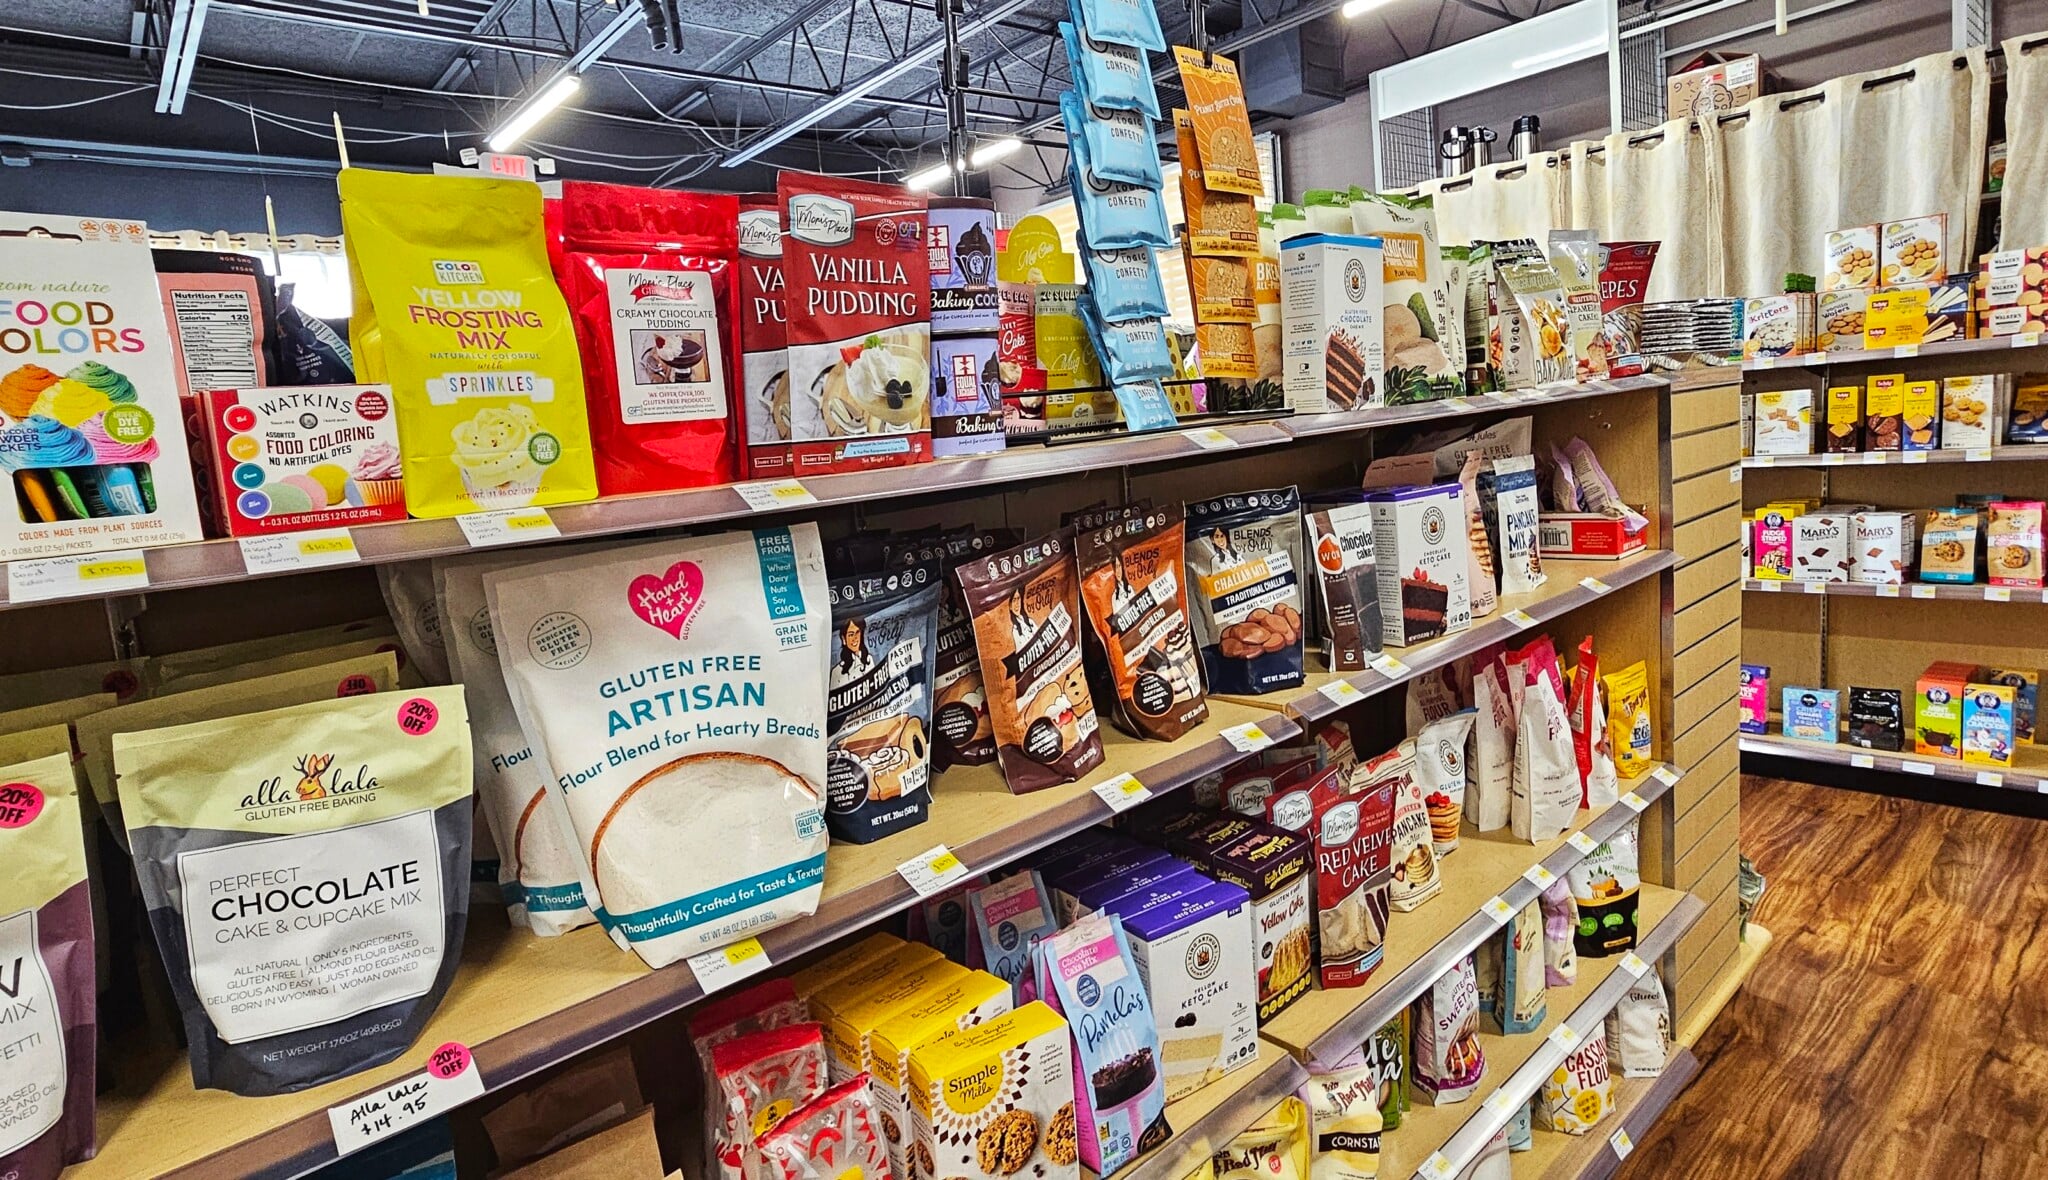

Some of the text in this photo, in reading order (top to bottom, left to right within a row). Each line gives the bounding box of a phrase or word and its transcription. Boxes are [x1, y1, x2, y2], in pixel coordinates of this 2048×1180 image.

[1111, 49, 1138, 61] LOGIC
[1106, 60, 1139, 79] CONFETTI
[1116, 116, 1142, 129] LOGIC
[1111, 128, 1144, 145] CONFETTI
[1108, 194, 1147, 209] CONFETTI
[799, 210, 849, 234] Mom's Place
[1122, 253, 1147, 263] LOGIC
[439, 271, 484, 282] KITCHEN
[809, 253, 909, 285] VANILLA
[1116, 267, 1149, 279] CONFETTI
[42, 281, 112, 293] nature
[667, 275, 695, 289] Place
[412, 286, 522, 308] YELLOW
[808, 287, 917, 316] PUDDING
[409, 305, 542, 329] FROSTING
[617, 309, 713, 319] CREAMY CHOCOLATE
[647, 319, 690, 328] PUDDING
[1340, 315, 1372, 323] CHOCOLATE
[457, 331, 511, 350] MIX
[1002, 331, 1026, 355] Cake
[1126, 329, 1157, 344] CONFETTI
[477, 361, 504, 370] with
[450, 375, 534, 393] SPRINKLES
[956, 375, 976, 388] EQUAL
[258, 394, 352, 416] WATKINS
[117, 427, 144, 436] FREE
[118, 418, 139, 429] DYE
[956, 416, 996, 435] Baking
[267, 426, 375, 454] FOOD COLORING
[1489, 445, 1511, 454] FREE
[269, 445, 351, 466] NO ARTIFICIAL DYES
[302, 513, 329, 523] BOTTLES
[1506, 509, 1537, 532] PANCAKE
[18, 520, 163, 541] COLORS MADE FROM PLANT SOURCES
[1234, 527, 1274, 540] BLENDS
[1801, 526, 1840, 538] MARY'S
[1856, 526, 1893, 538] MARY'S
[66, 541, 93, 549] PACKETS
[759, 535, 789, 547] FREE
[761, 544, 791, 555] FROM
[1508, 530, 1527, 551] MIX
[1125, 548, 1159, 567] BLENDS
[1356, 548, 1372, 561] cake
[1419, 554, 1451, 565] KETO CAKE
[1423, 548, 1447, 556] CHOCOLATE
[767, 563, 791, 573] Wheat
[1137, 561, 1157, 579] Orly
[769, 574, 789, 584] Dairy
[1214, 568, 1253, 592] CHALLAH
[637, 570, 689, 609] Hand
[770, 584, 788, 594] Nuts
[1226, 576, 1286, 606] TRADITIONAL CHALLAH
[648, 591, 693, 626] Heart
[772, 595, 786, 605] Soy
[775, 604, 800, 615] GMOs
[536, 623, 577, 646] DEDICATED
[775, 623, 808, 636] GRAIN
[540, 629, 581, 653] GLUTEN
[550, 640, 576, 657] FREE
[781, 633, 807, 646] FREE
[599, 656, 761, 698] GLUTEN FREE
[830, 662, 889, 713] GLUTEN-FREE
[410, 702, 433, 720] 20%
[608, 682, 766, 737] ARTISAN
[1423, 701, 1452, 721] FLOUR
[1921, 711, 1957, 720] COOKIES
[403, 716, 425, 732] OFF
[1967, 721, 2009, 730] CRACKERS
[1970, 716, 2006, 724] ANIMAL
[559, 720, 820, 795] Flour Blend for Hearty Breads
[241, 764, 379, 808] alla lala
[246, 792, 376, 822] GLUTEN FREE BAKING
[1392, 811, 1428, 844] PANCAKE
[1320, 849, 1350, 873] RED
[210, 866, 300, 895] PERFECT
[1342, 856, 1378, 888] CAKE
[211, 860, 420, 922] CHOCOLATE
[216, 889, 421, 944] CAKE CUPCAKE MIX
[621, 880, 786, 935] Thoughtfully Crafted for Taste
[1261, 895, 1305, 932] Yellow Cake
[256, 931, 413, 973] NATURAL ONLY INGREDIENTS
[1062, 946, 1098, 968] Chocolate
[226, 938, 419, 990] GLUTEN FREE ALMOND FLOUR BASED
[1064, 965, 1082, 977] Cake
[207, 978, 313, 1006] DELICIOUS EASY
[231, 961, 418, 1013] BORN WYOMING WOMAN OWNED
[1181, 981, 1229, 1010] KETO CAKE
[1194, 981, 1216, 993] YELLOW
[1080, 986, 1144, 1053] Pamela's
[286, 1041, 327, 1057] WEIGHT
[432, 1046, 462, 1067] 20%
[440, 1061, 463, 1076] OFF
[949, 1064, 998, 1093] Simple
[350, 1080, 428, 1125] Alla lala
[960, 1084, 994, 1104] Mills
[1340, 1088, 1357, 1110] Red
